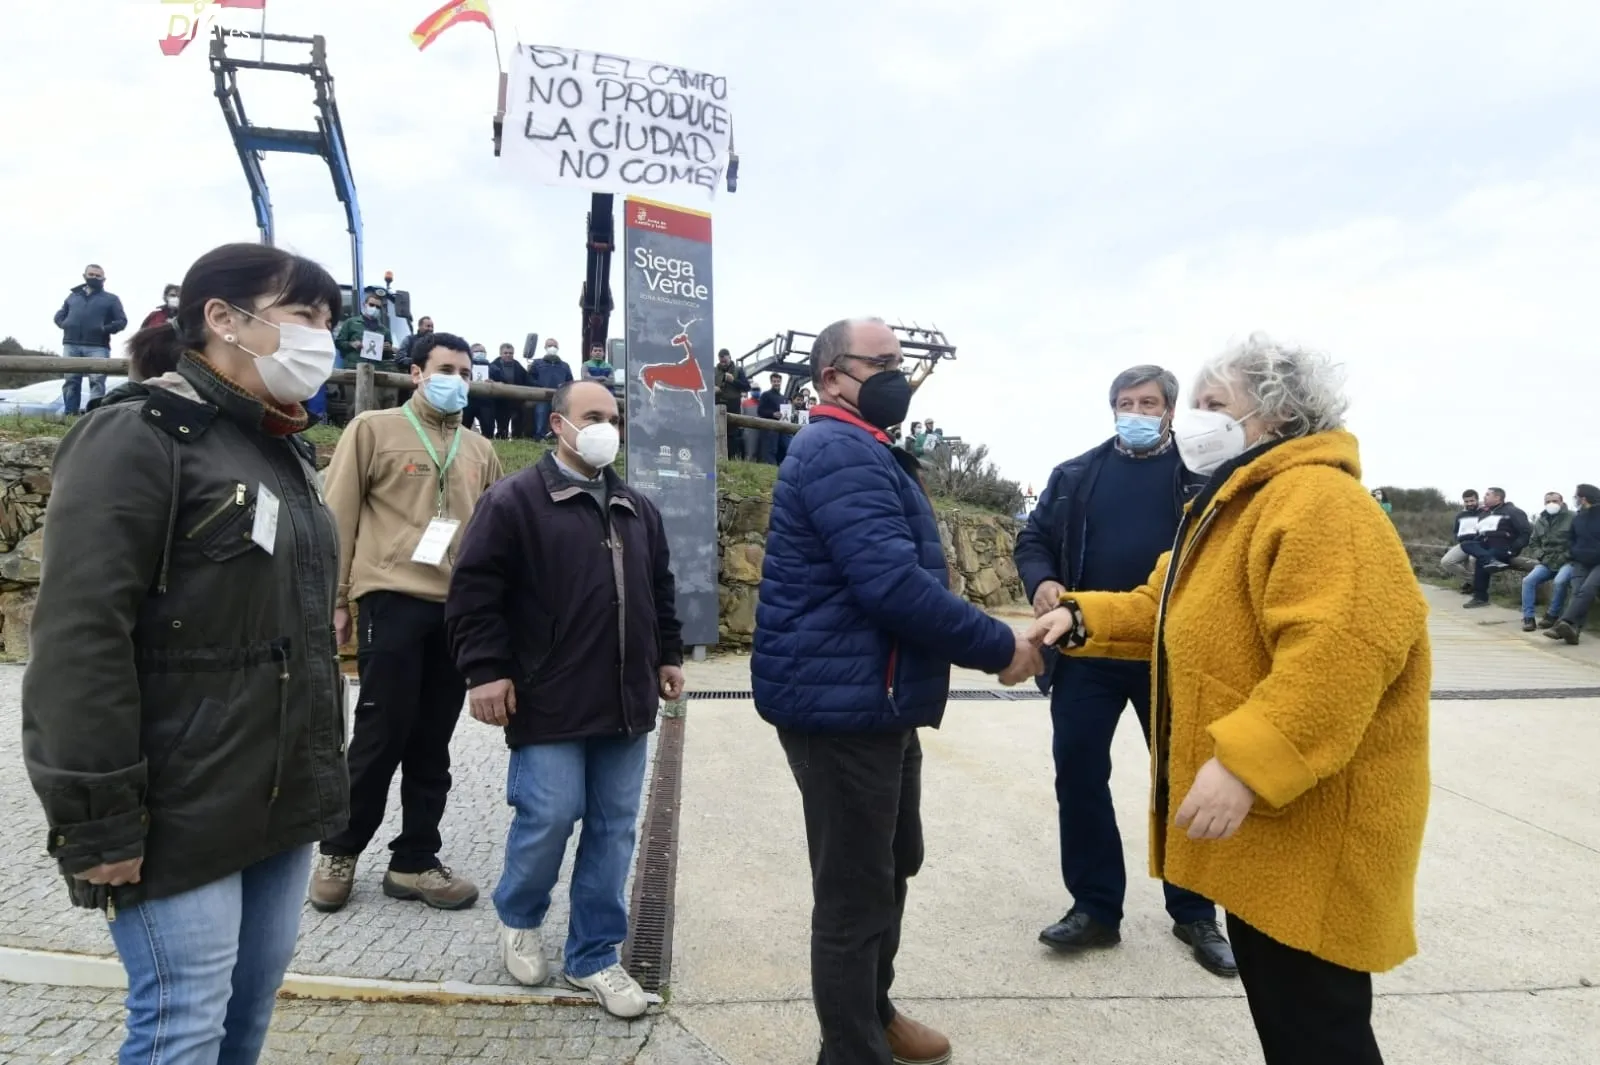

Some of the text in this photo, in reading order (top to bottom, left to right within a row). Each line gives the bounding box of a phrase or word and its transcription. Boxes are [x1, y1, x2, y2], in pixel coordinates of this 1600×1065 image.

[529, 45, 727, 100] SI EL CAMPO
[527, 76, 728, 134] NO PRODUCE
[524, 111, 577, 142] LA
[559, 150, 719, 190] NO COME
[634, 247, 695, 279] Siega
[643, 269, 708, 300] Verde
